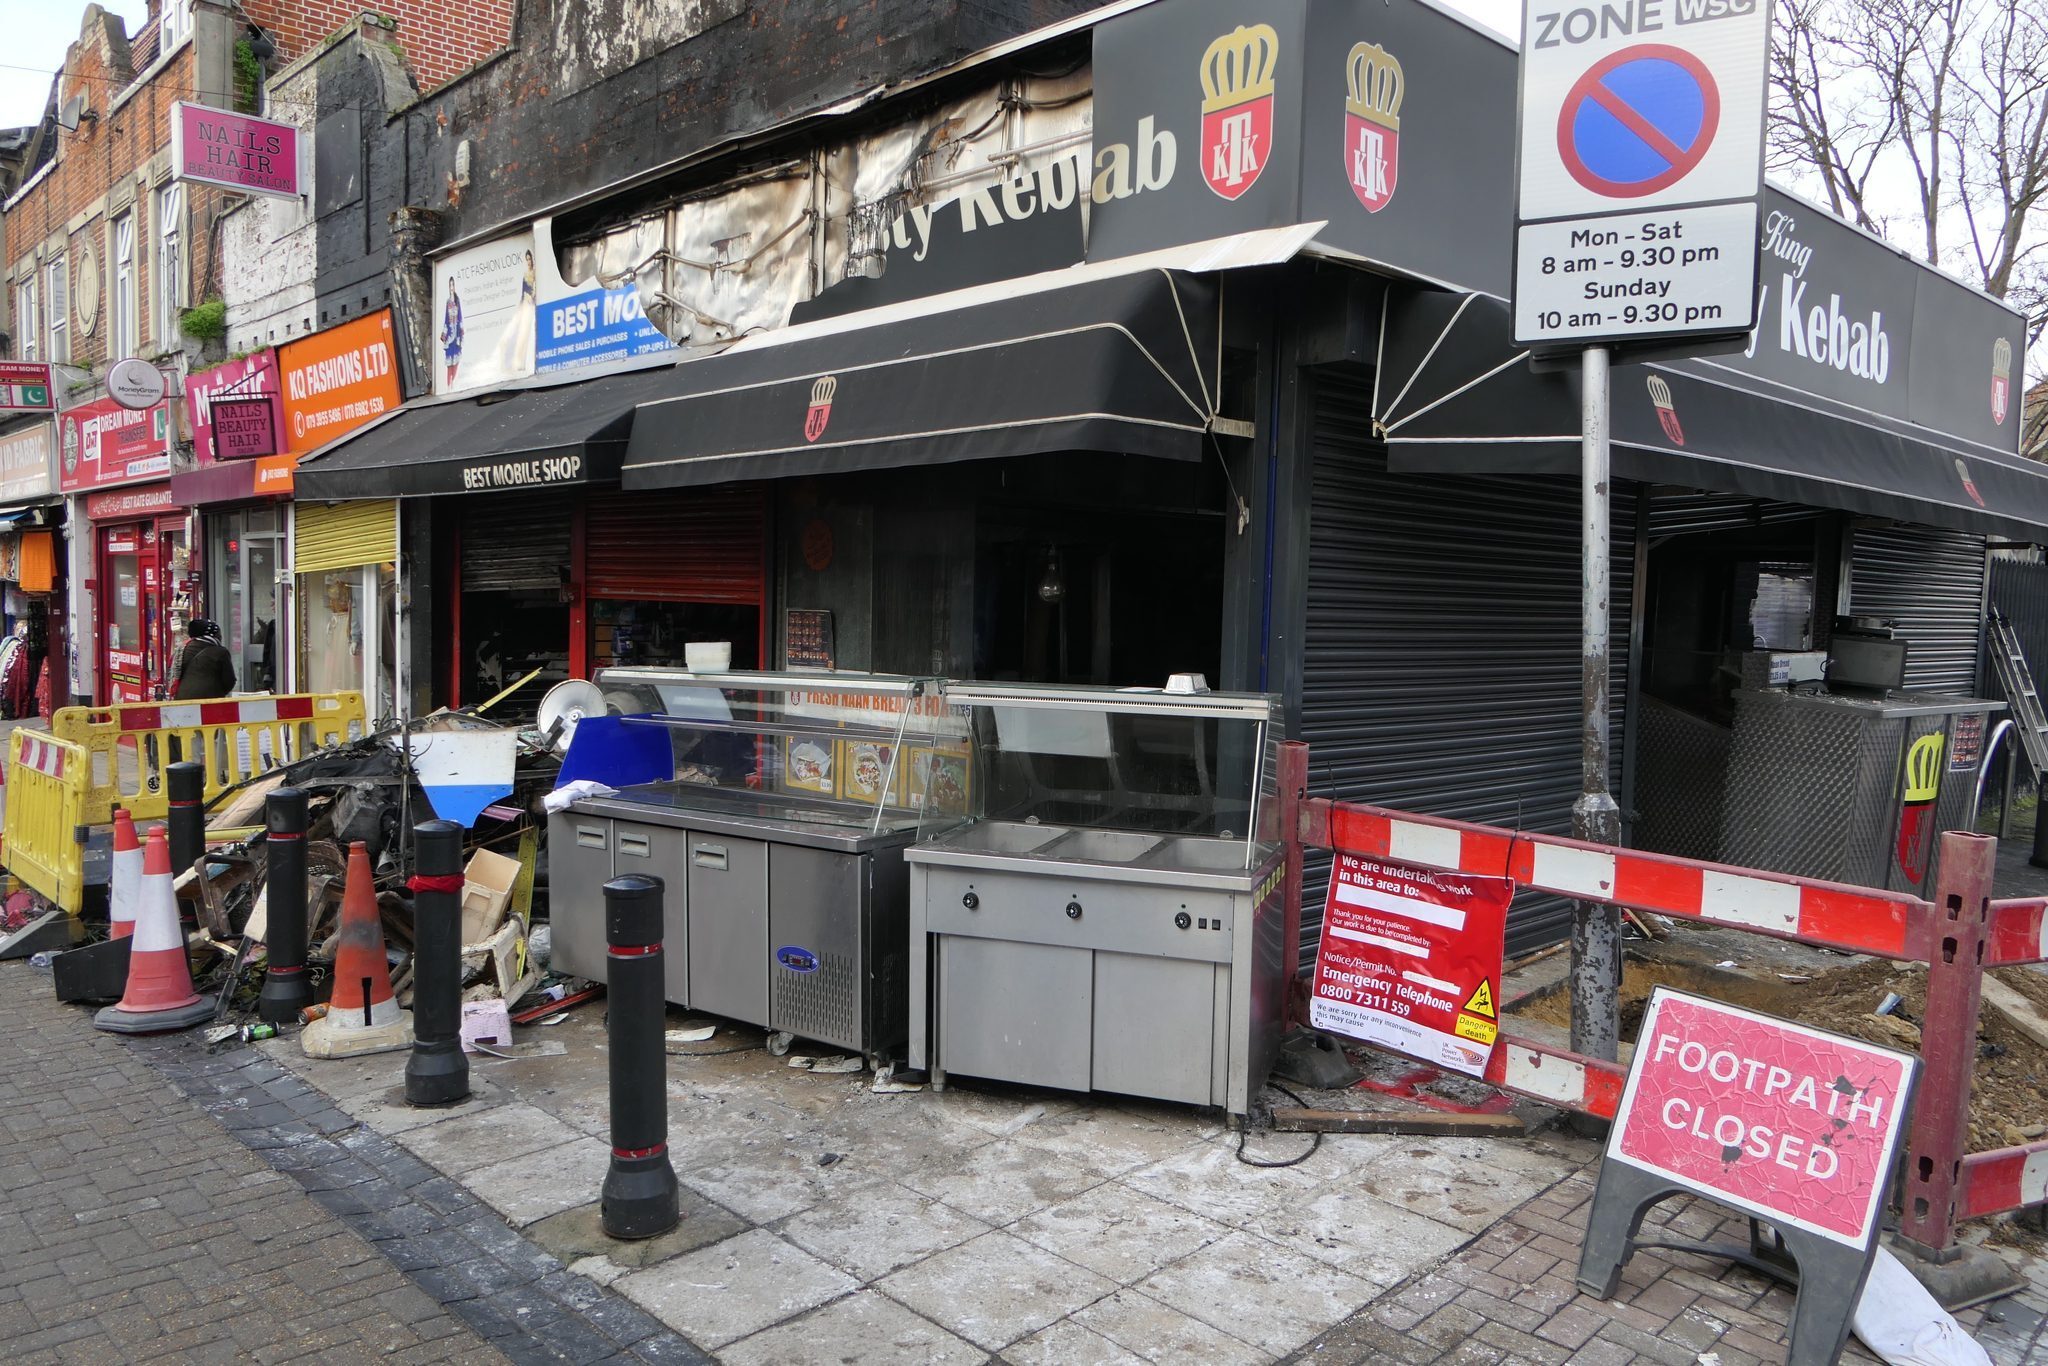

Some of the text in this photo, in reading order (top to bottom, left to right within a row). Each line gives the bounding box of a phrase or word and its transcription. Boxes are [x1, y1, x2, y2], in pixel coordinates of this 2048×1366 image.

[1534, 0, 1751, 50] ZONE WSC
[198, 121, 280, 155] NAILS
[207, 145, 274, 174] HAIR
[188, 162, 292, 190] BEAUTY SALON
[1570, 230, 1618, 248] Mon
[1641, 221, 1682, 241] Sat
[1761, 210, 1813, 278] King
[471, 258, 501, 276] FASHION
[502, 251, 523, 269] LOOK
[1542, 257, 1555, 275] 8
[1563, 258, 1597, 273] am
[1620, 246, 1675, 268] 9.30
[1682, 246, 1719, 266] pm
[1584, 278, 1671, 299] Sunday
[552, 290, 646, 338] BEST MO
[1537, 311, 1562, 329] 10
[1568, 312, 1601, 327] am
[1623, 303, 1678, 324] 9.30
[1685, 304, 1722, 324] pm
[1780, 272, 1889, 384] Kebab
[538, 349, 557, 359] MOBILE
[557, 346, 575, 356] PHONE
[575, 341, 591, 352] SALES
[596, 332, 628, 346] PURCHASES
[638, 341, 664, 354] TOP-UPS
[289, 342, 389, 400] KQ FASHIONS LTD
[537, 364, 557, 375] MOBILE
[562, 356, 591, 370] COMPUTER
[590, 349, 628, 363] ACCESSORIES
[100, 410, 123, 432] DREAM
[221, 405, 262, 419] NAILS
[217, 419, 267, 433] BEAUTY
[13, 435, 44, 469] FABRIC
[228, 433, 261, 448] HAIR
[463, 455, 581, 489] BEST MOBILE SHOP
[122, 496, 133, 509] BEST
[134, 494, 145, 507] RATE
[842, 693, 869, 710] NAAN
[914, 696, 921, 715] 3
[1342, 855, 1358, 868] We
[1361, 861, 1380, 873] are
[1339, 869, 1420, 896] in this area to:
[1333, 908, 1351, 918] Thank
[1352, 913, 1364, 921] you
[1364, 914, 1372, 922] for
[1372, 918, 1386, 926] your
[1344, 920, 1359, 929] work
[1366, 923, 1377, 932] due
[1378, 926, 1384, 934] to
[1385, 928, 1392, 936] be
[1392, 931, 1422, 944] completed
[1324, 951, 1397, 976] Notice/Permit No.
[1320, 983, 1410, 1016] 0800 7311 559
[1323, 965, 1453, 1012] Emergency Telephone
[1316, 1011, 1365, 1028] this may cause
[1317, 1003, 1422, 1038] We are sorry for any inconvenience
[1459, 1016, 1486, 1030] Danger
[1465, 1029, 1487, 1040] death
[1441, 1053, 1465, 1064] Networks
[1442, 1047, 1457, 1056] Power
[1654, 1033, 1883, 1128] FOOTPATH
[1662, 1097, 1840, 1180] CLOSED
